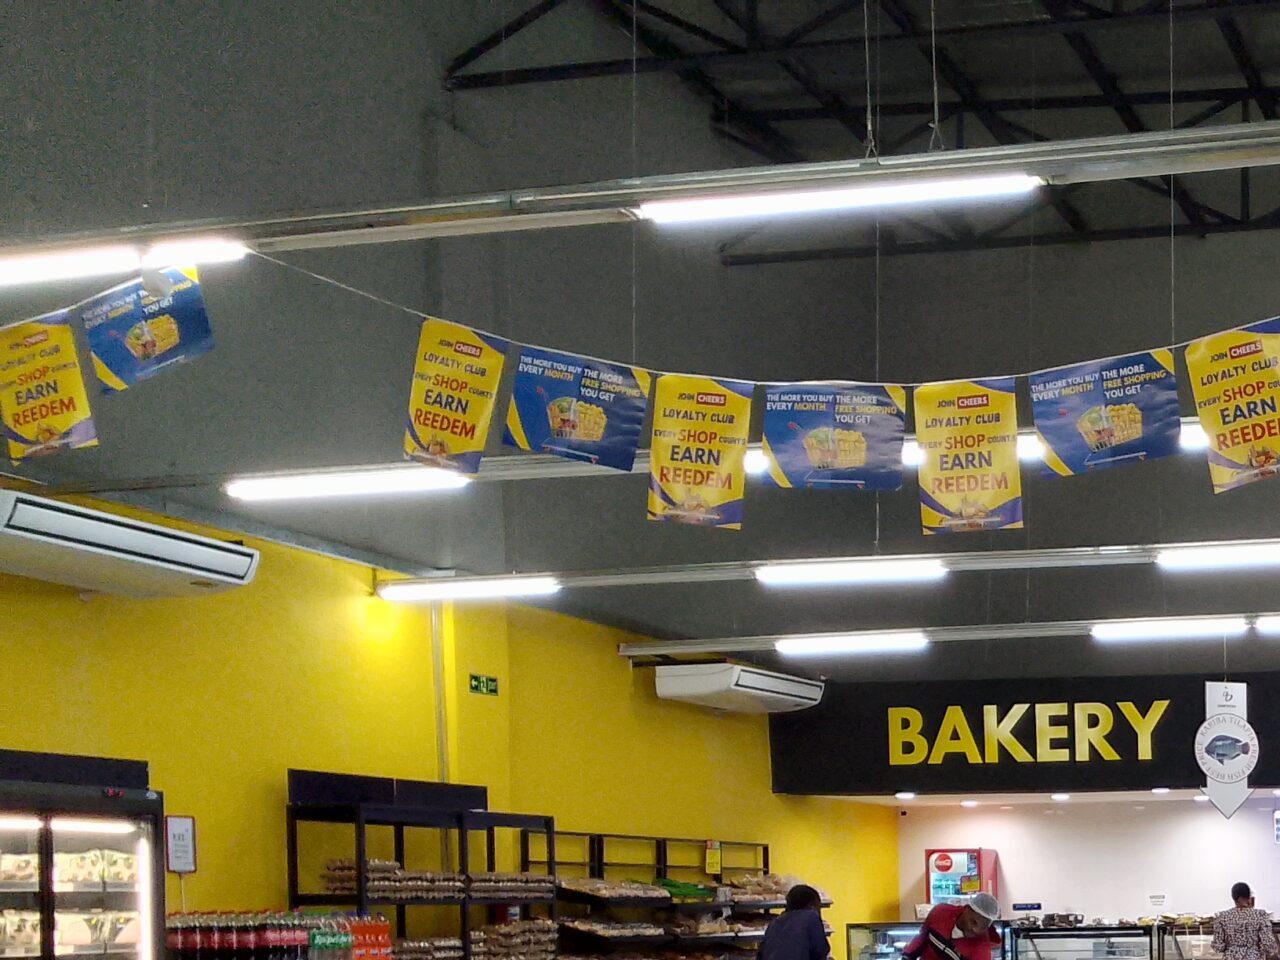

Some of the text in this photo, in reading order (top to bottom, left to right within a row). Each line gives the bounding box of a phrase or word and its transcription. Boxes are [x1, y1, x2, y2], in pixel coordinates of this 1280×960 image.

[1201, 357, 1278, 386] LOYALTY CLUB
[15, 380, 58, 405] EARN
[433, 374, 468, 393] SHOP
[1223, 380, 1265, 402] SHOP
[13, 397, 76, 428] REEDEM
[424, 389, 468, 414] EARN
[1220, 396, 1276, 425] EARN
[414, 409, 476, 439] REEDEM
[663, 408, 735, 423] LOYALTY CLUB
[926, 413, 1000, 428] LOYALTY CLUB
[678, 430, 717, 443] SHOP
[945, 434, 985, 449] SHOP
[670, 446, 720, 465] EARN
[939, 451, 992, 471] EARN
[660, 467, 732, 489] REEDEM
[931, 472, 1008, 494] REEDEM
[888, 700, 1170, 766] BAKERY
